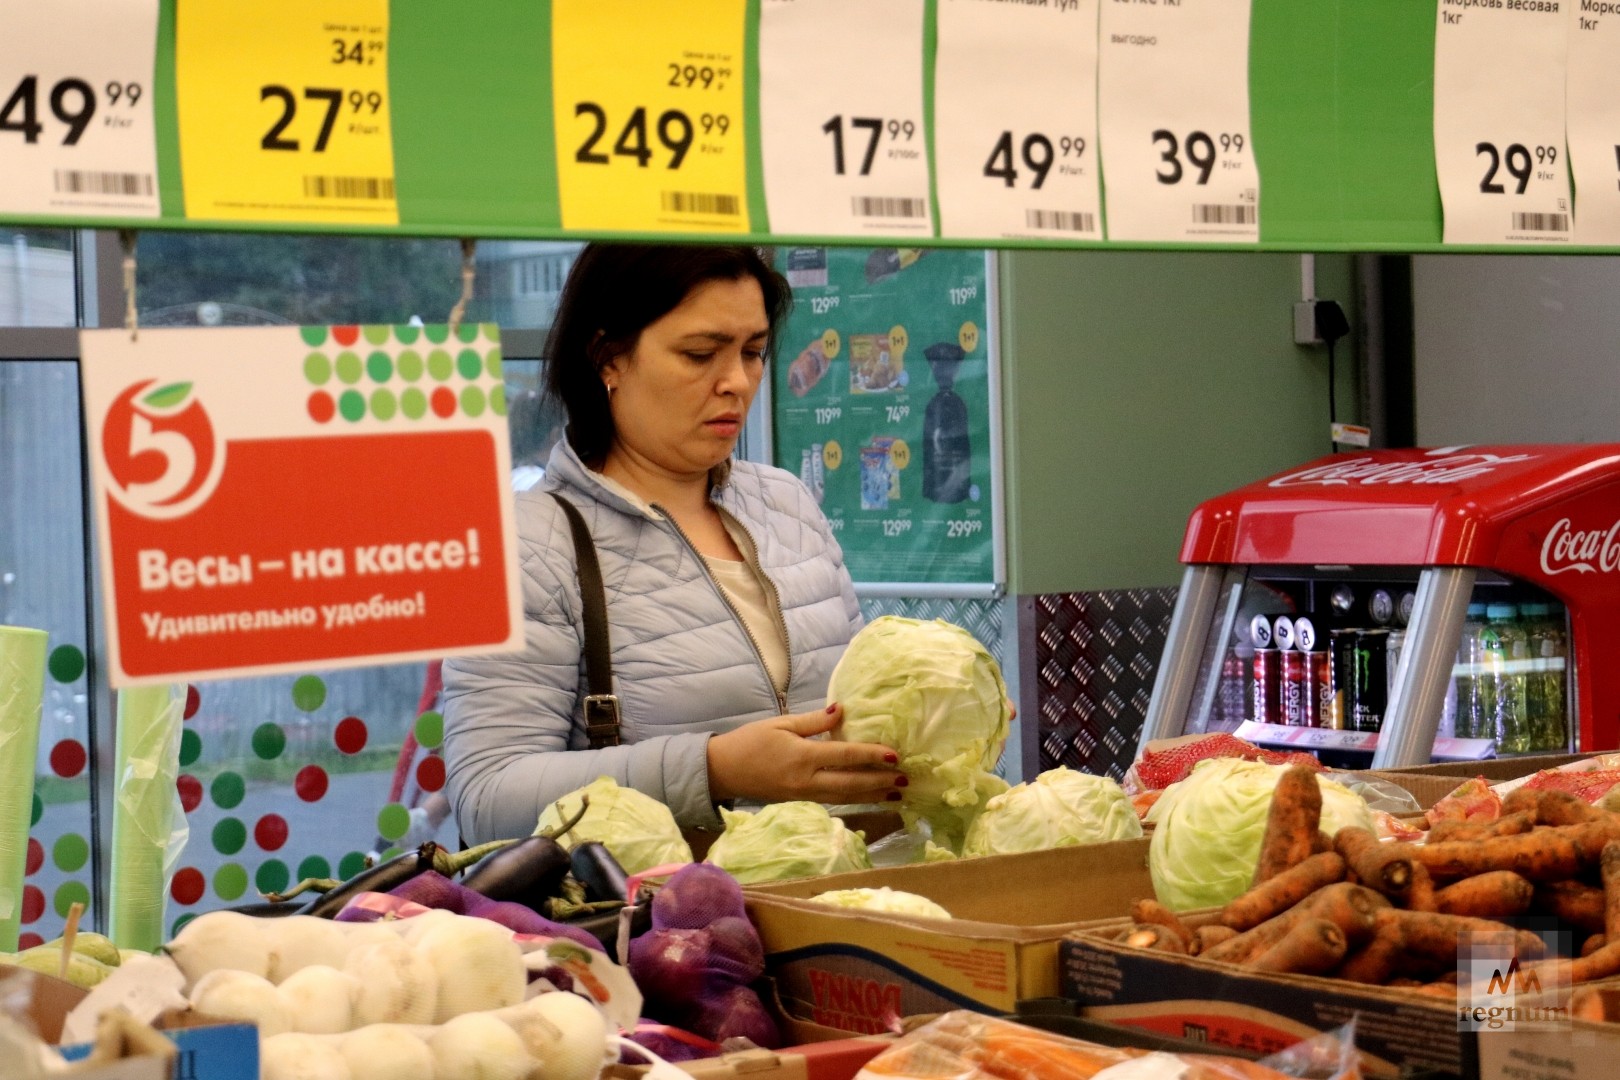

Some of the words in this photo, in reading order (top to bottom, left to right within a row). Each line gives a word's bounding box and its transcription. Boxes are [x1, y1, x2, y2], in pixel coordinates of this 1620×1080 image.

[1442, 10, 1463, 24] 1кг
[1579, 16, 1599, 30] 1кг
[332, 39, 364, 65] 34
[668, 63, 715, 89] 299
[0, 74, 98, 146] 49
[105, 80, 143, 108] 99
[259, 84, 345, 153] 27
[348, 90, 383, 116] 99
[574, 101, 695, 171] 249
[700, 112, 731, 137] 99
[821, 114, 884, 176] 17
[887, 119, 916, 141] 99
[983, 130, 1056, 190] 49
[1059, 136, 1087, 159] 99
[1151, 128, 1217, 186] 39
[1219, 132, 1245, 154] 99
[1475, 141, 1533, 195] 29
[1535, 145, 1557, 165] 99
[137, 549, 253, 591] Весы
[291, 547, 346, 579] на
[354, 528, 482, 576] кассе!
[140, 606, 318, 641] Удивительно
[321, 591, 427, 630] удобно!
